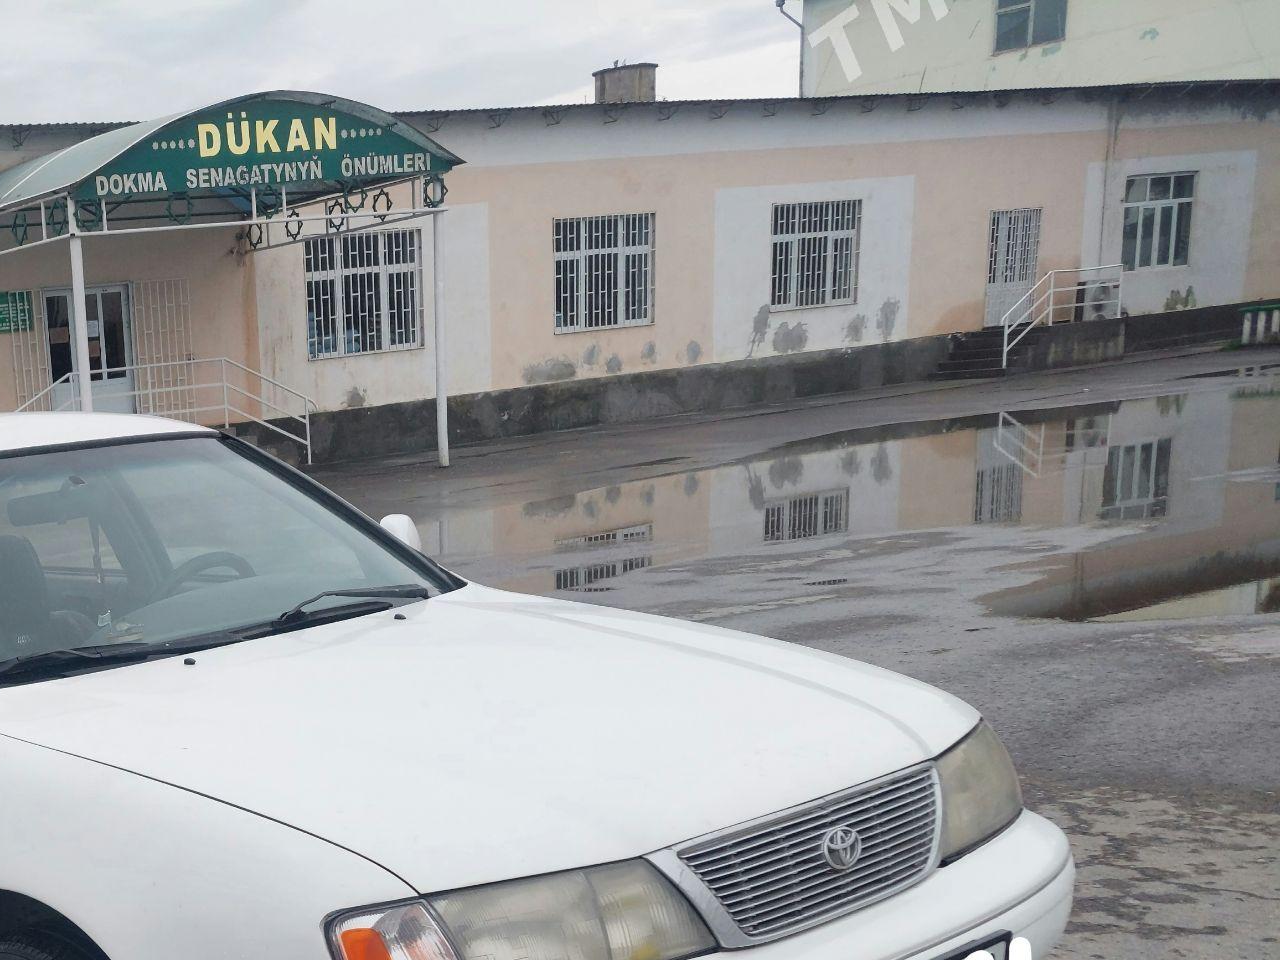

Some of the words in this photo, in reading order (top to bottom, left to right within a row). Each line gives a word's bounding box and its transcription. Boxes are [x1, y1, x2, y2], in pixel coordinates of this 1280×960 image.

[197, 111, 338, 158] DÜKAN
[95, 171, 168, 196] DOKMA
[186, 155, 323, 189] SENAGATYNYŇ
[341, 152, 431, 177] ÖNÜMLERI
